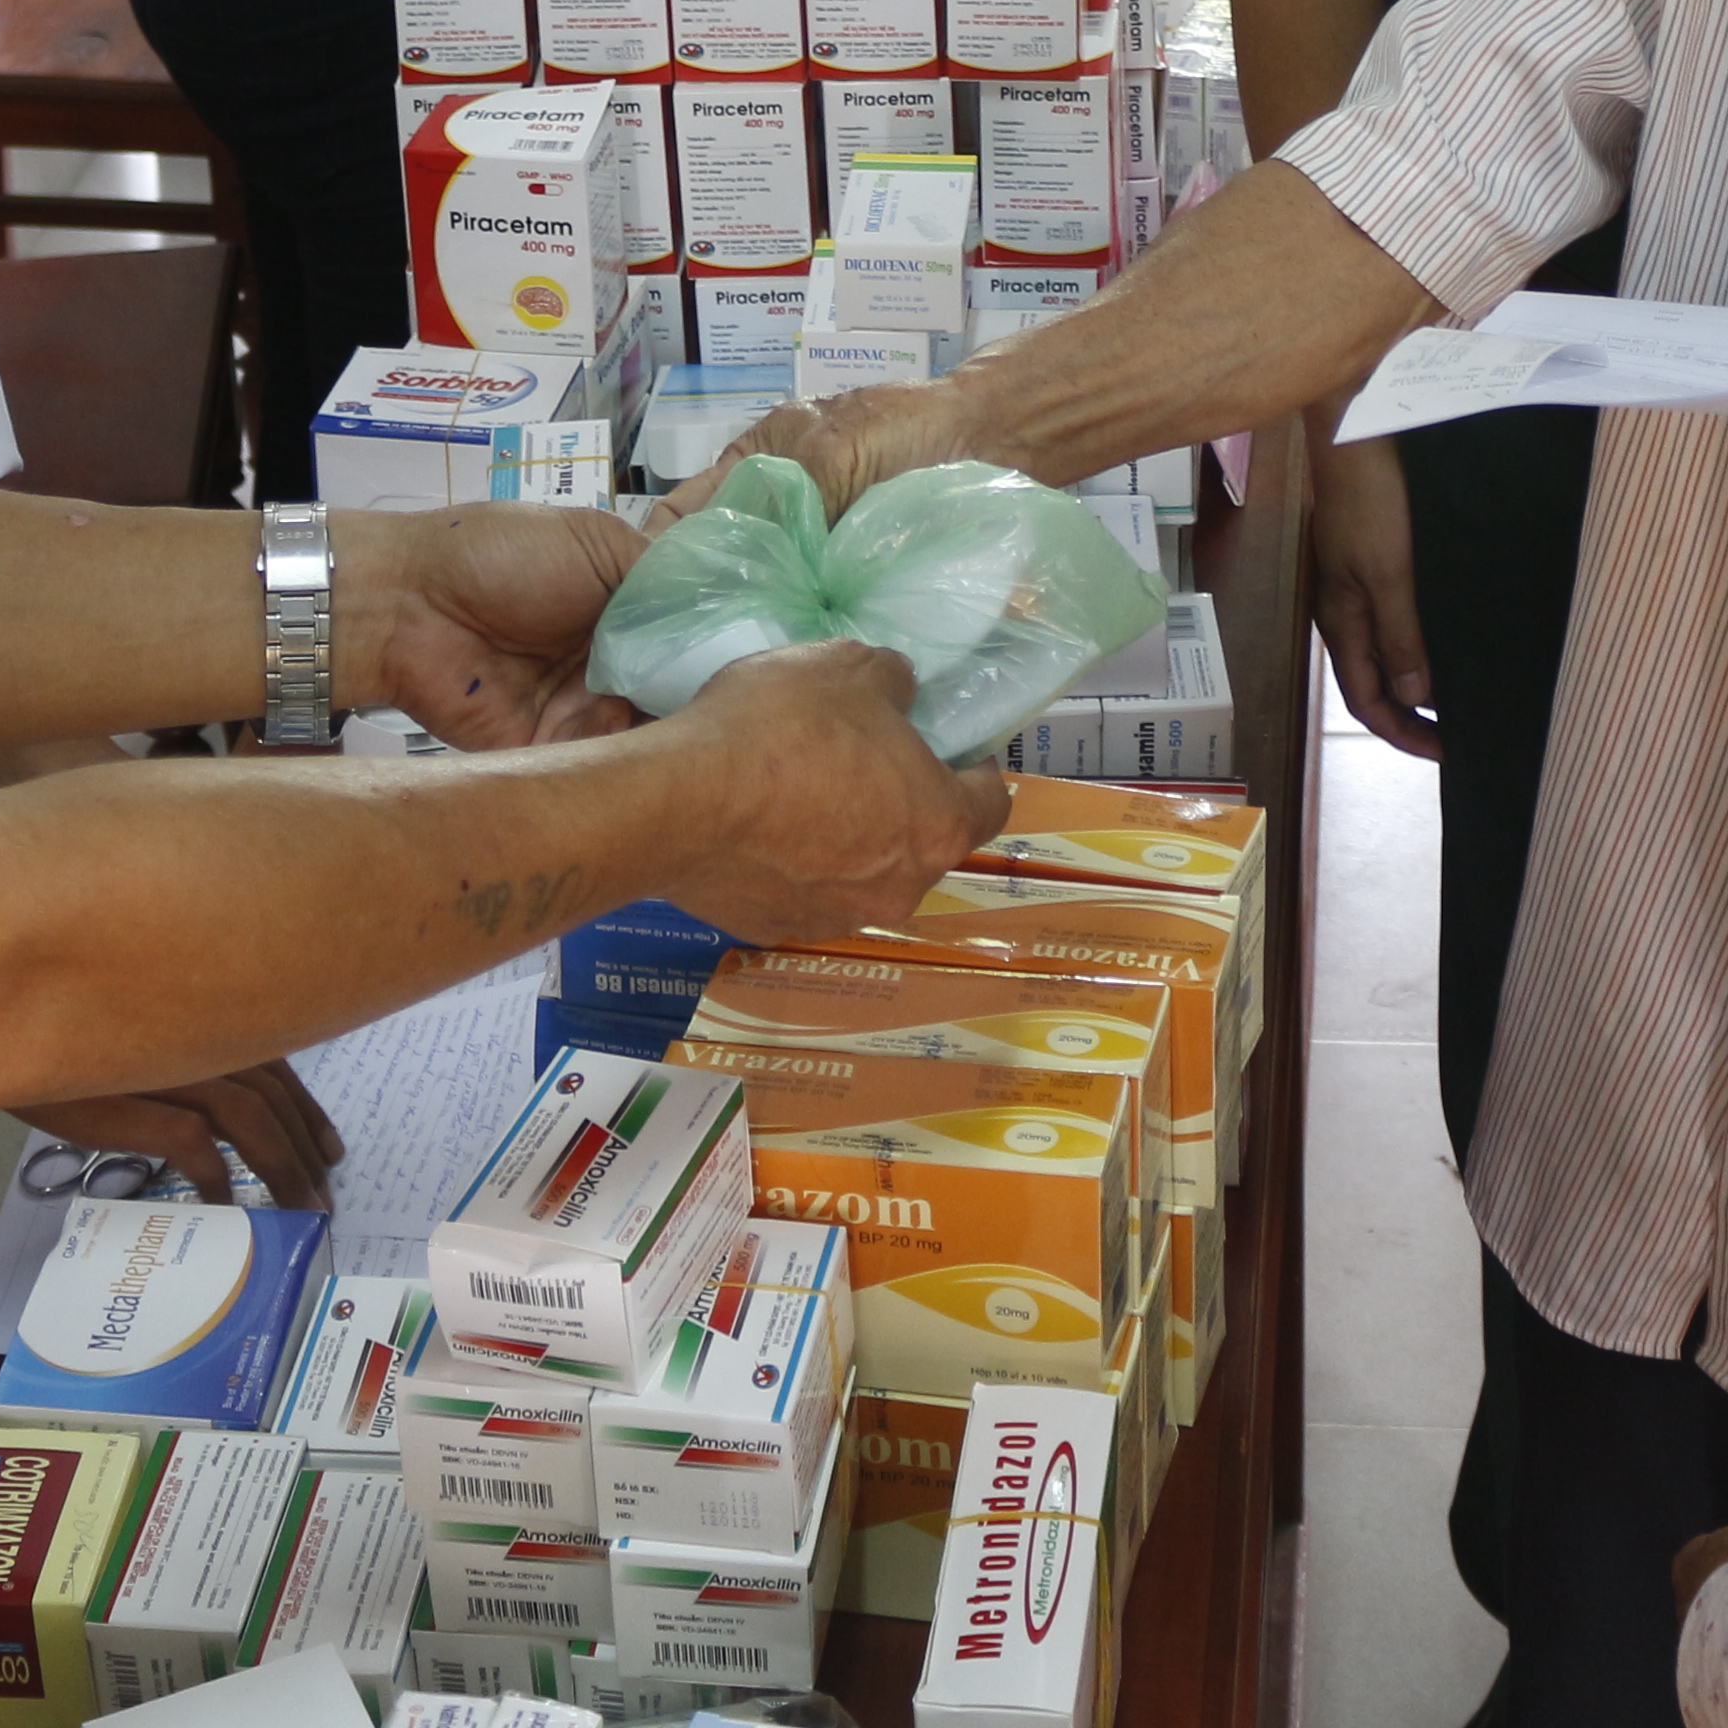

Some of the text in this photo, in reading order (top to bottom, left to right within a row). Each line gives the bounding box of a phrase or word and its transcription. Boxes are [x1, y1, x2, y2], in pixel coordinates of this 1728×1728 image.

[843, 92, 934, 107] Piracetam
[1000, 86, 1091, 102] Piracetam
[464, 109, 585, 123] Piracetam
[693, 102, 783, 117] Piracetam
[894, 109, 935, 120] 400 mg
[1051, 105, 1091, 117] 400 mg
[526, 123, 581, 133] 400 mg
[744, 119, 784, 130] 400 mg
[1128, 85, 1143, 163] Piracetam
[516, 171, 540, 180] GMP
[549, 173, 574, 182] WHO
[449, 211, 573, 237] Piracetam
[521, 241, 576, 257] 400 mg
[844, 258, 953, 275] DICLOFENAC 50mg
[990, 278, 1080, 294] Piracetam
[715, 289, 805, 306] Piracetam
[1040, 296, 1060, 305] 400
[766, 306, 787, 316] 400
[808, 347, 917, 364] DICLOFENAC 50mg
[376, 371, 531, 393] Sorbitol
[468, 393, 507, 407] 5g
[1037, 724, 1050, 752] 500
[1169, 720, 1182, 748] 500
[734, 948, 904, 983] Virazom
[1031, 942, 1203, 983] Virazom
[594, 972, 622, 992] B6
[1058, 1032, 1094, 1047] 20mg
[681, 1042, 856, 1079] Virazom
[1016, 1131, 1052, 1144] 20mg
[553, 1134, 629, 1228] Amoxicilin
[531, 1182, 568, 1222] 500 mg
[756, 1185, 935, 1231] azom
[62, 1235, 79, 1260] GMP
[76, 1207, 95, 1228] WHO
[858, 1231, 944, 1254] BP 20 mg
[734, 1232, 760, 1272] 500 mg
[86, 1214, 175, 1353] Mectathepharm
[994, 1305, 1031, 1321] 20mg
[452, 1342, 541, 1367] Amoxicilin
[970, 1366, 991, 1381] Hộp
[1030, 1372, 1044, 1383] 10
[220, 1395, 235, 1409] Box
[358, 1400, 371, 1419] 500
[491, 1403, 584, 1424] Amoxicilin
[688, 1434, 782, 1455] Amoxicilin
[765, 1457, 780, 1468] mg
[614, 1497, 640, 1507] NSX:
[517, 1528, 608, 1547] Amoxicilin
[954, 1421, 1039, 1661] Metronidazol
[708, 1573, 802, 1592] Amoxicilin
